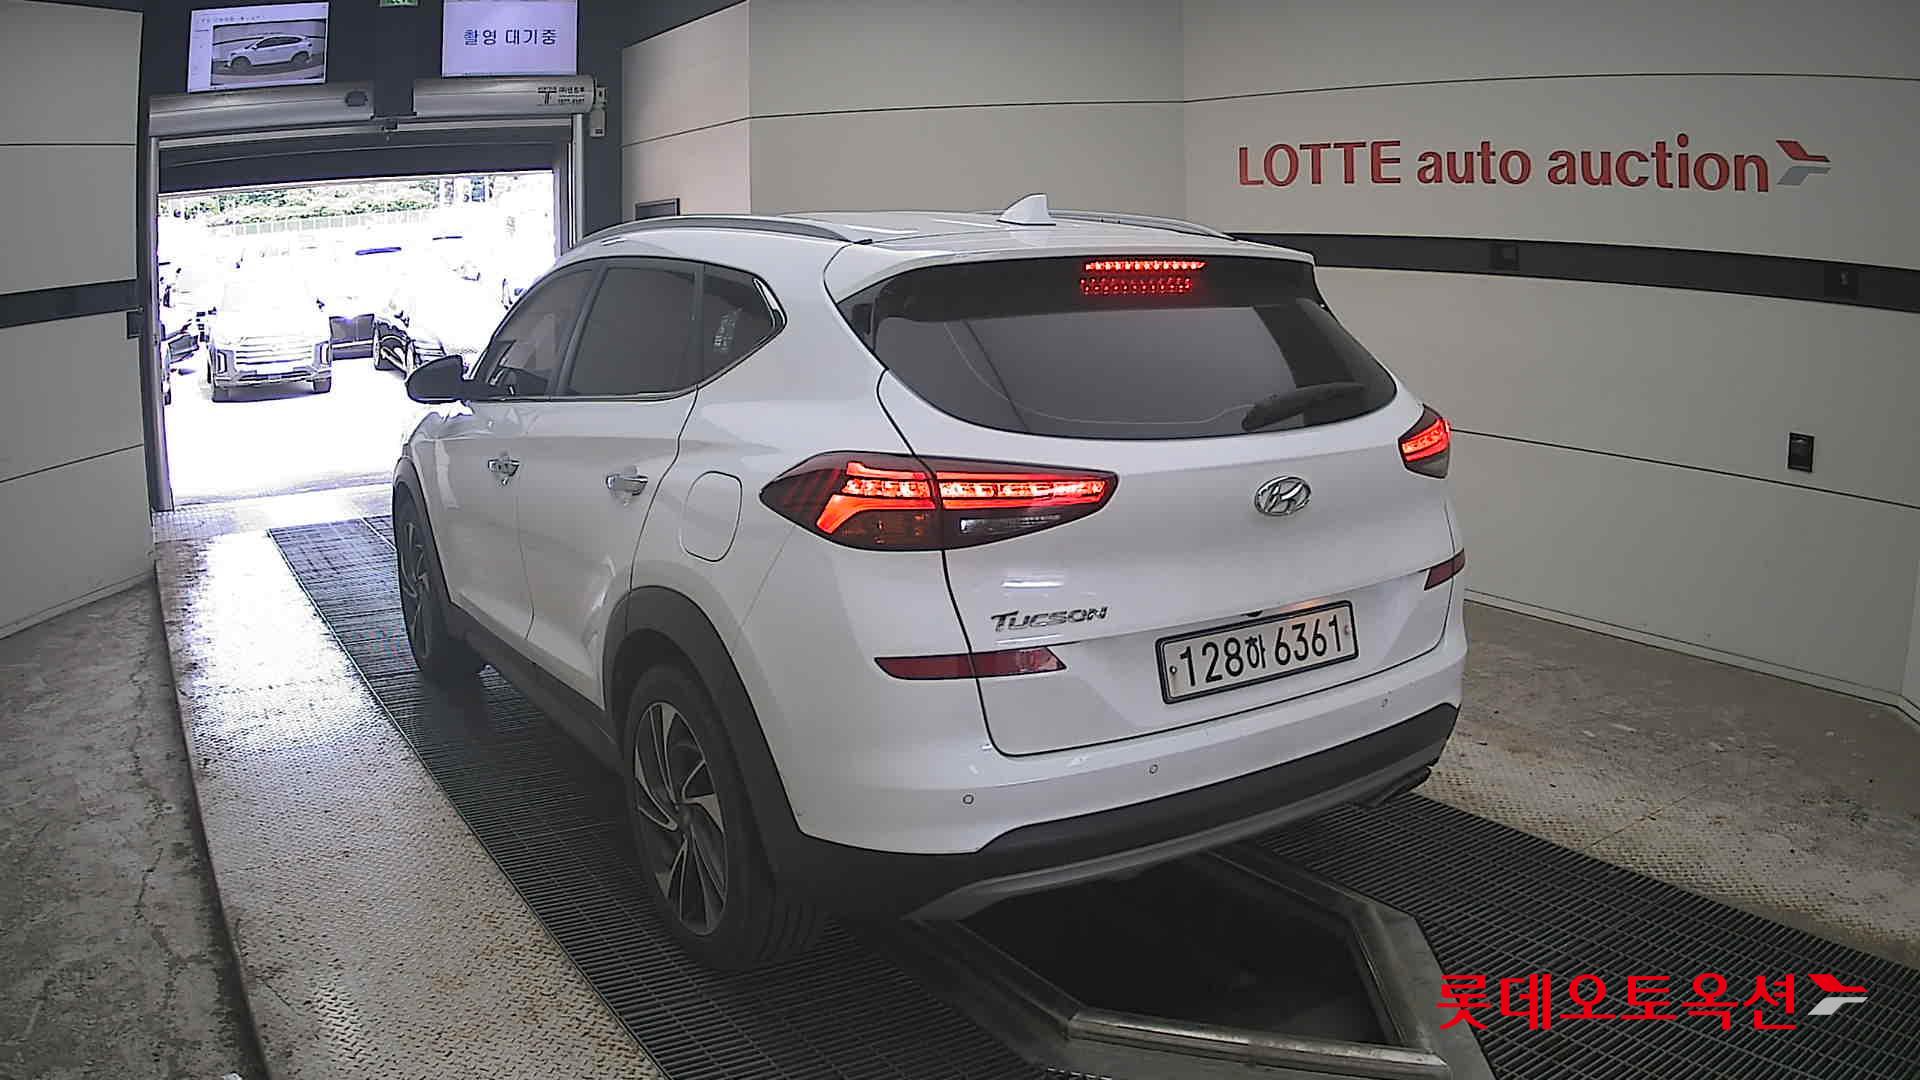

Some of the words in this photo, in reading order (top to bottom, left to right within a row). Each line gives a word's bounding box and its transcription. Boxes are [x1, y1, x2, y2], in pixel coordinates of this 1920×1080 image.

[464, 29, 498, 46] 촬영
[505, 29, 558, 46] 대기중
[1238, 140, 1401, 186] LOTTE
[1416, 140, 1532, 185] auto
[1547, 132, 1769, 193] auction
[1273, 613, 1343, 667] 6361
